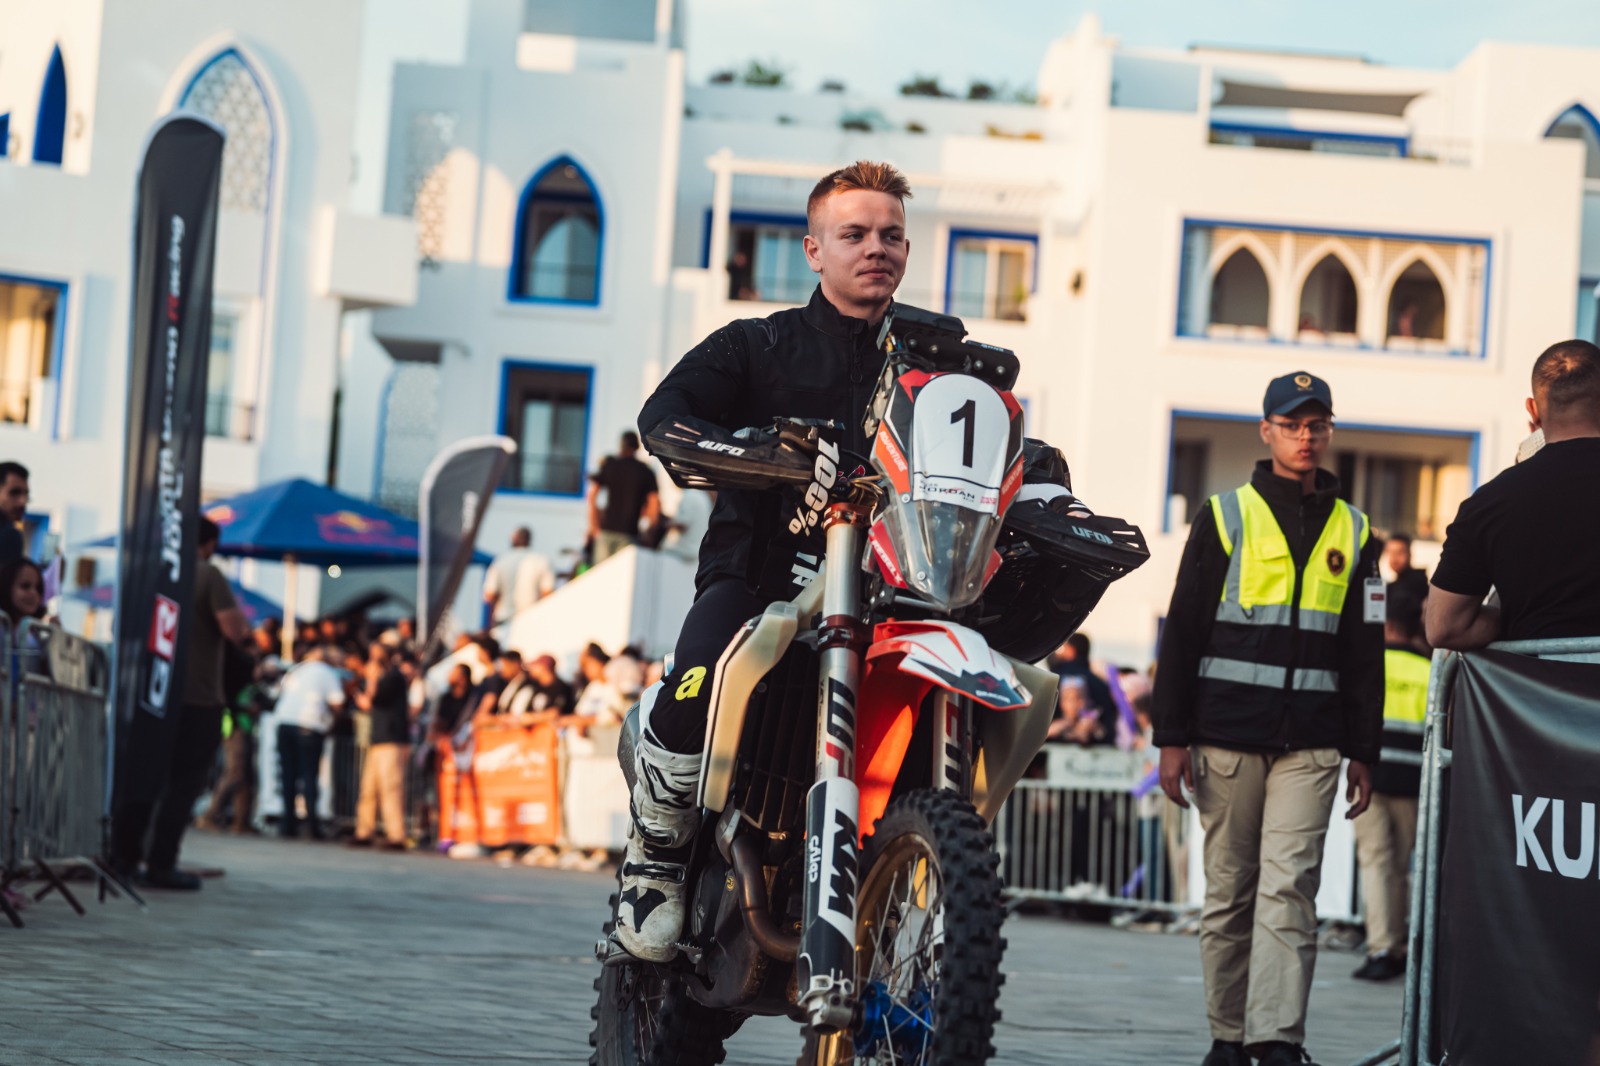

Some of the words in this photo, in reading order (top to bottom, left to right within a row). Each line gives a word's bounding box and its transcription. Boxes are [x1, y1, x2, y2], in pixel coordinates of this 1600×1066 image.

[706, 441, 746, 457] UFO
[950, 399, 975, 468] 1
[789, 438, 840, 537] 100%
[1072, 525, 1105, 543] UFO
[827, 808, 858, 921] KTM
[1511, 793, 1600, 880] KU
